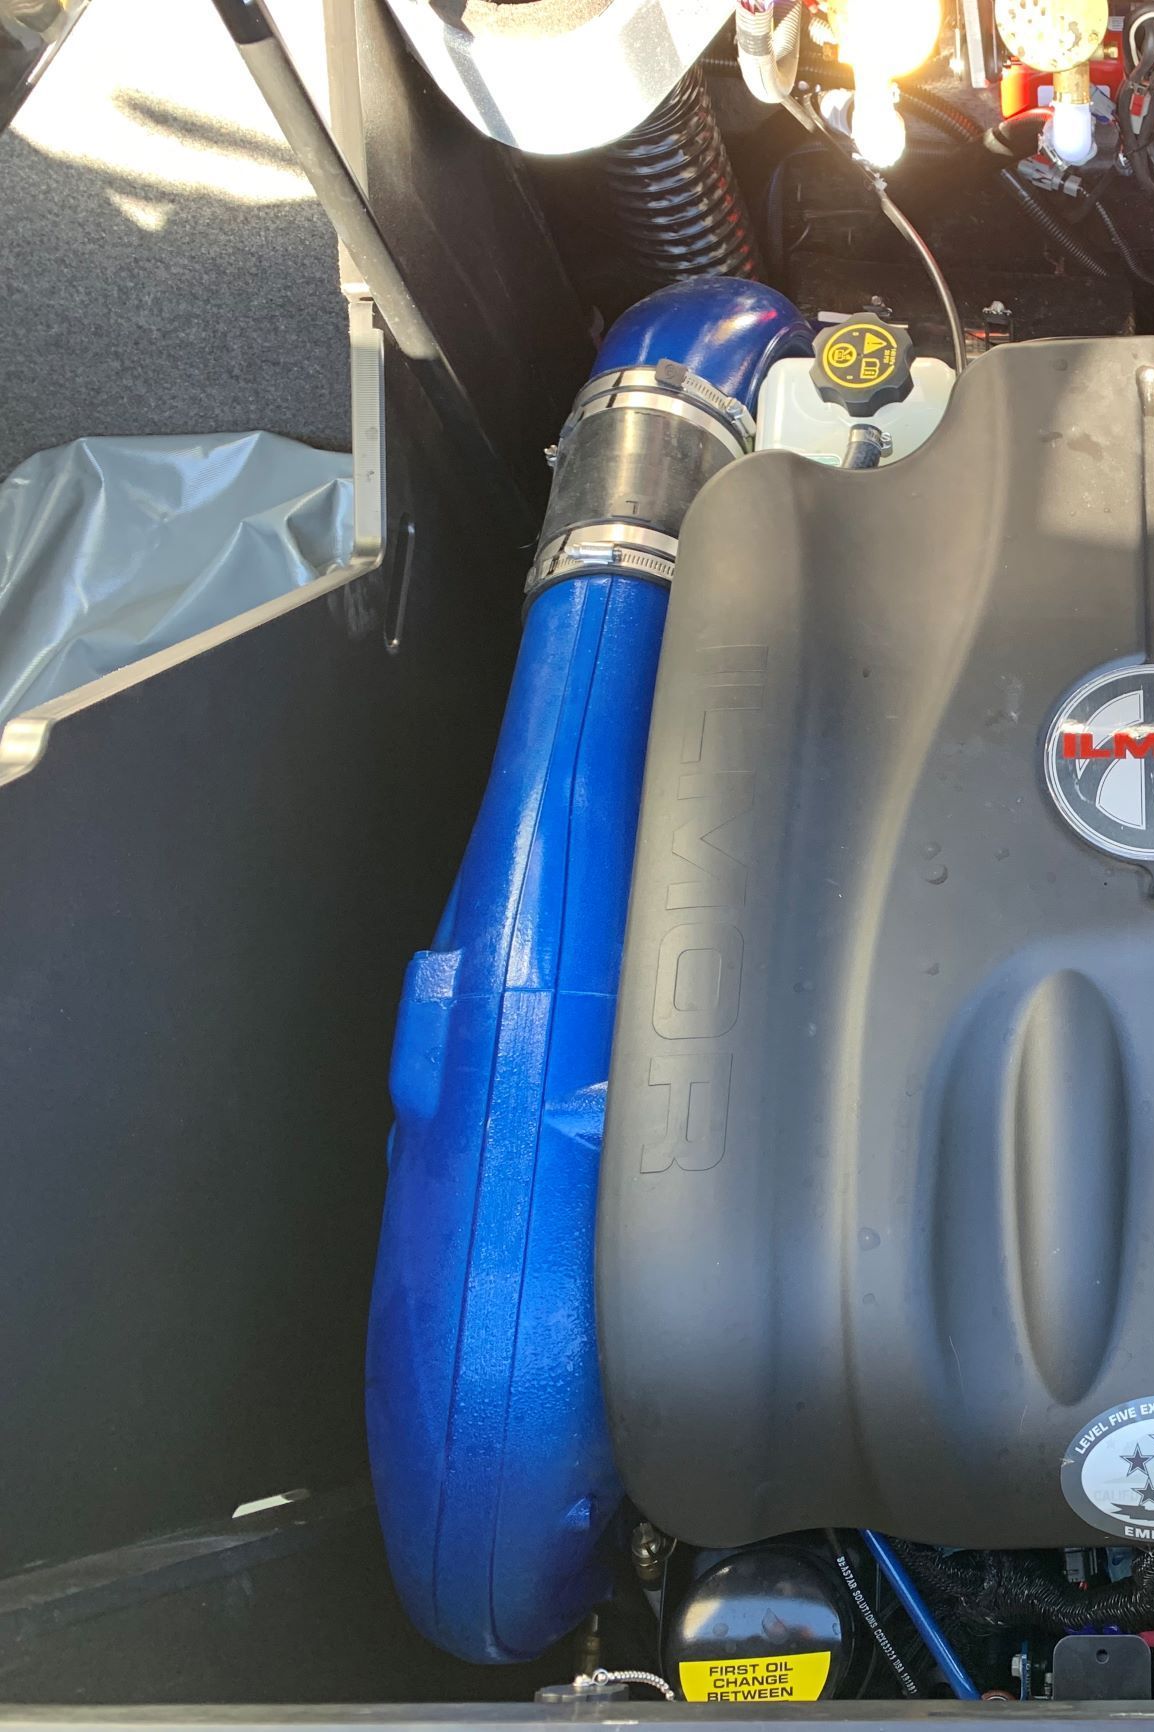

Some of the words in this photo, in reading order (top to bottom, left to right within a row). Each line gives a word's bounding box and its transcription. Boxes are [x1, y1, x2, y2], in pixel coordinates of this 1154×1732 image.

[640, 644, 769, 1175] ILMOR
[1074, 1423, 1109, 1455] LEVEL
[1108, 1406, 1138, 1428] FIVE
[836, 1555, 857, 1590] SEASTAR
[852, 1590, 878, 1629] SOLUTIONS
[709, 1663, 760, 1677] FIRST
[765, 1661, 794, 1673] OIL
[713, 1673, 789, 1689] CHANGE
[707, 1686, 794, 1702] BETWEEN
